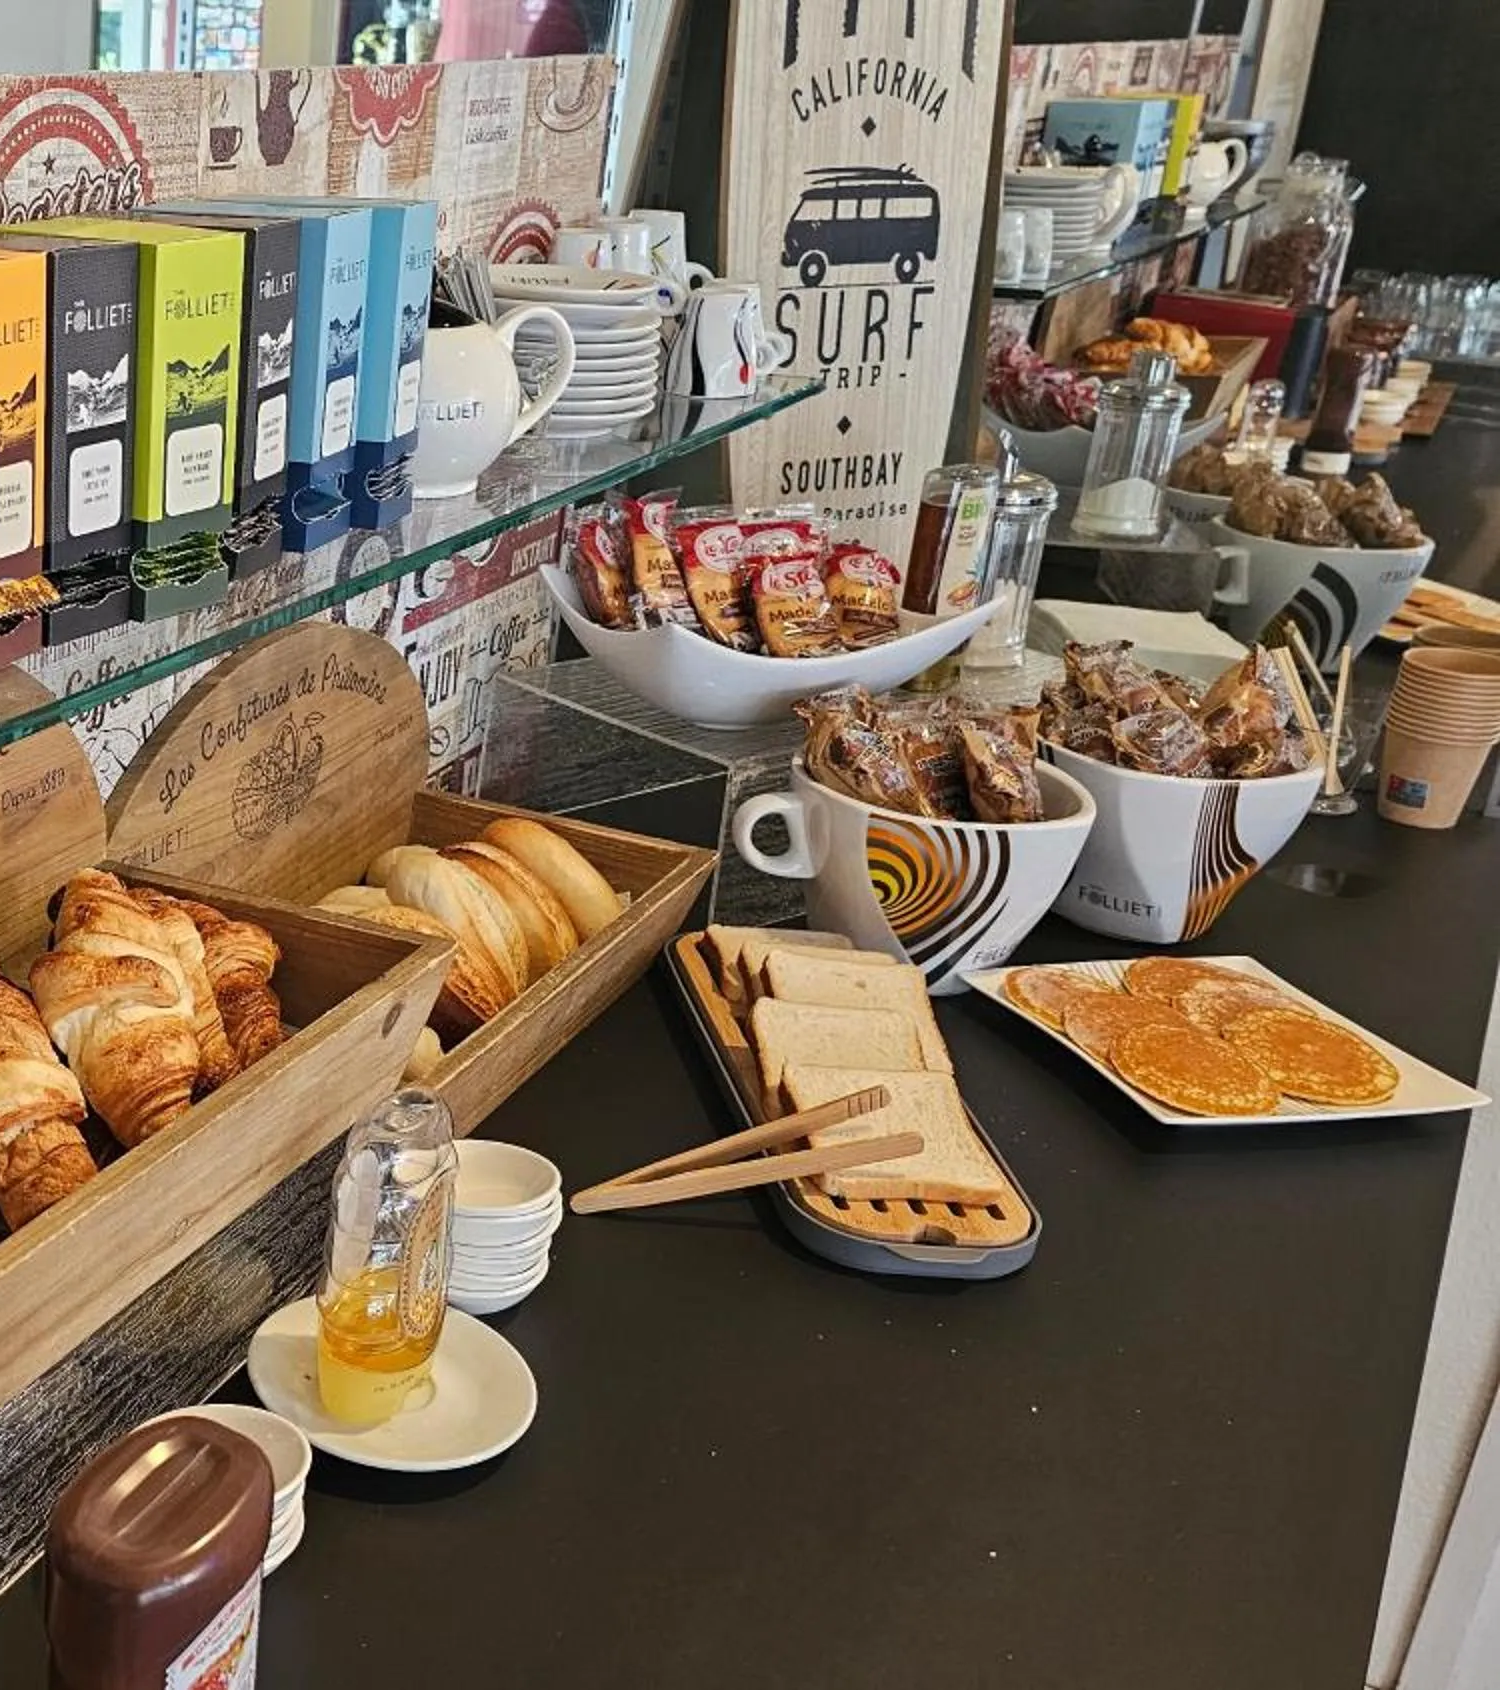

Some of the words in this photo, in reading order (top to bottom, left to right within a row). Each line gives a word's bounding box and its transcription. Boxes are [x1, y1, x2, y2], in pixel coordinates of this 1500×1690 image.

[791, 57, 948, 123] CALIFORNIA
[64, 302, 127, 335] FOLLIET
[164, 292, 228, 321] FOLLIET
[776, 286, 935, 369] SURF
[819, 365, 882, 389] TRIP
[781, 452, 903, 495] SOUTHBAY
[296, 667, 316, 698] de
[1078, 886, 1154, 917] FOLLIET
